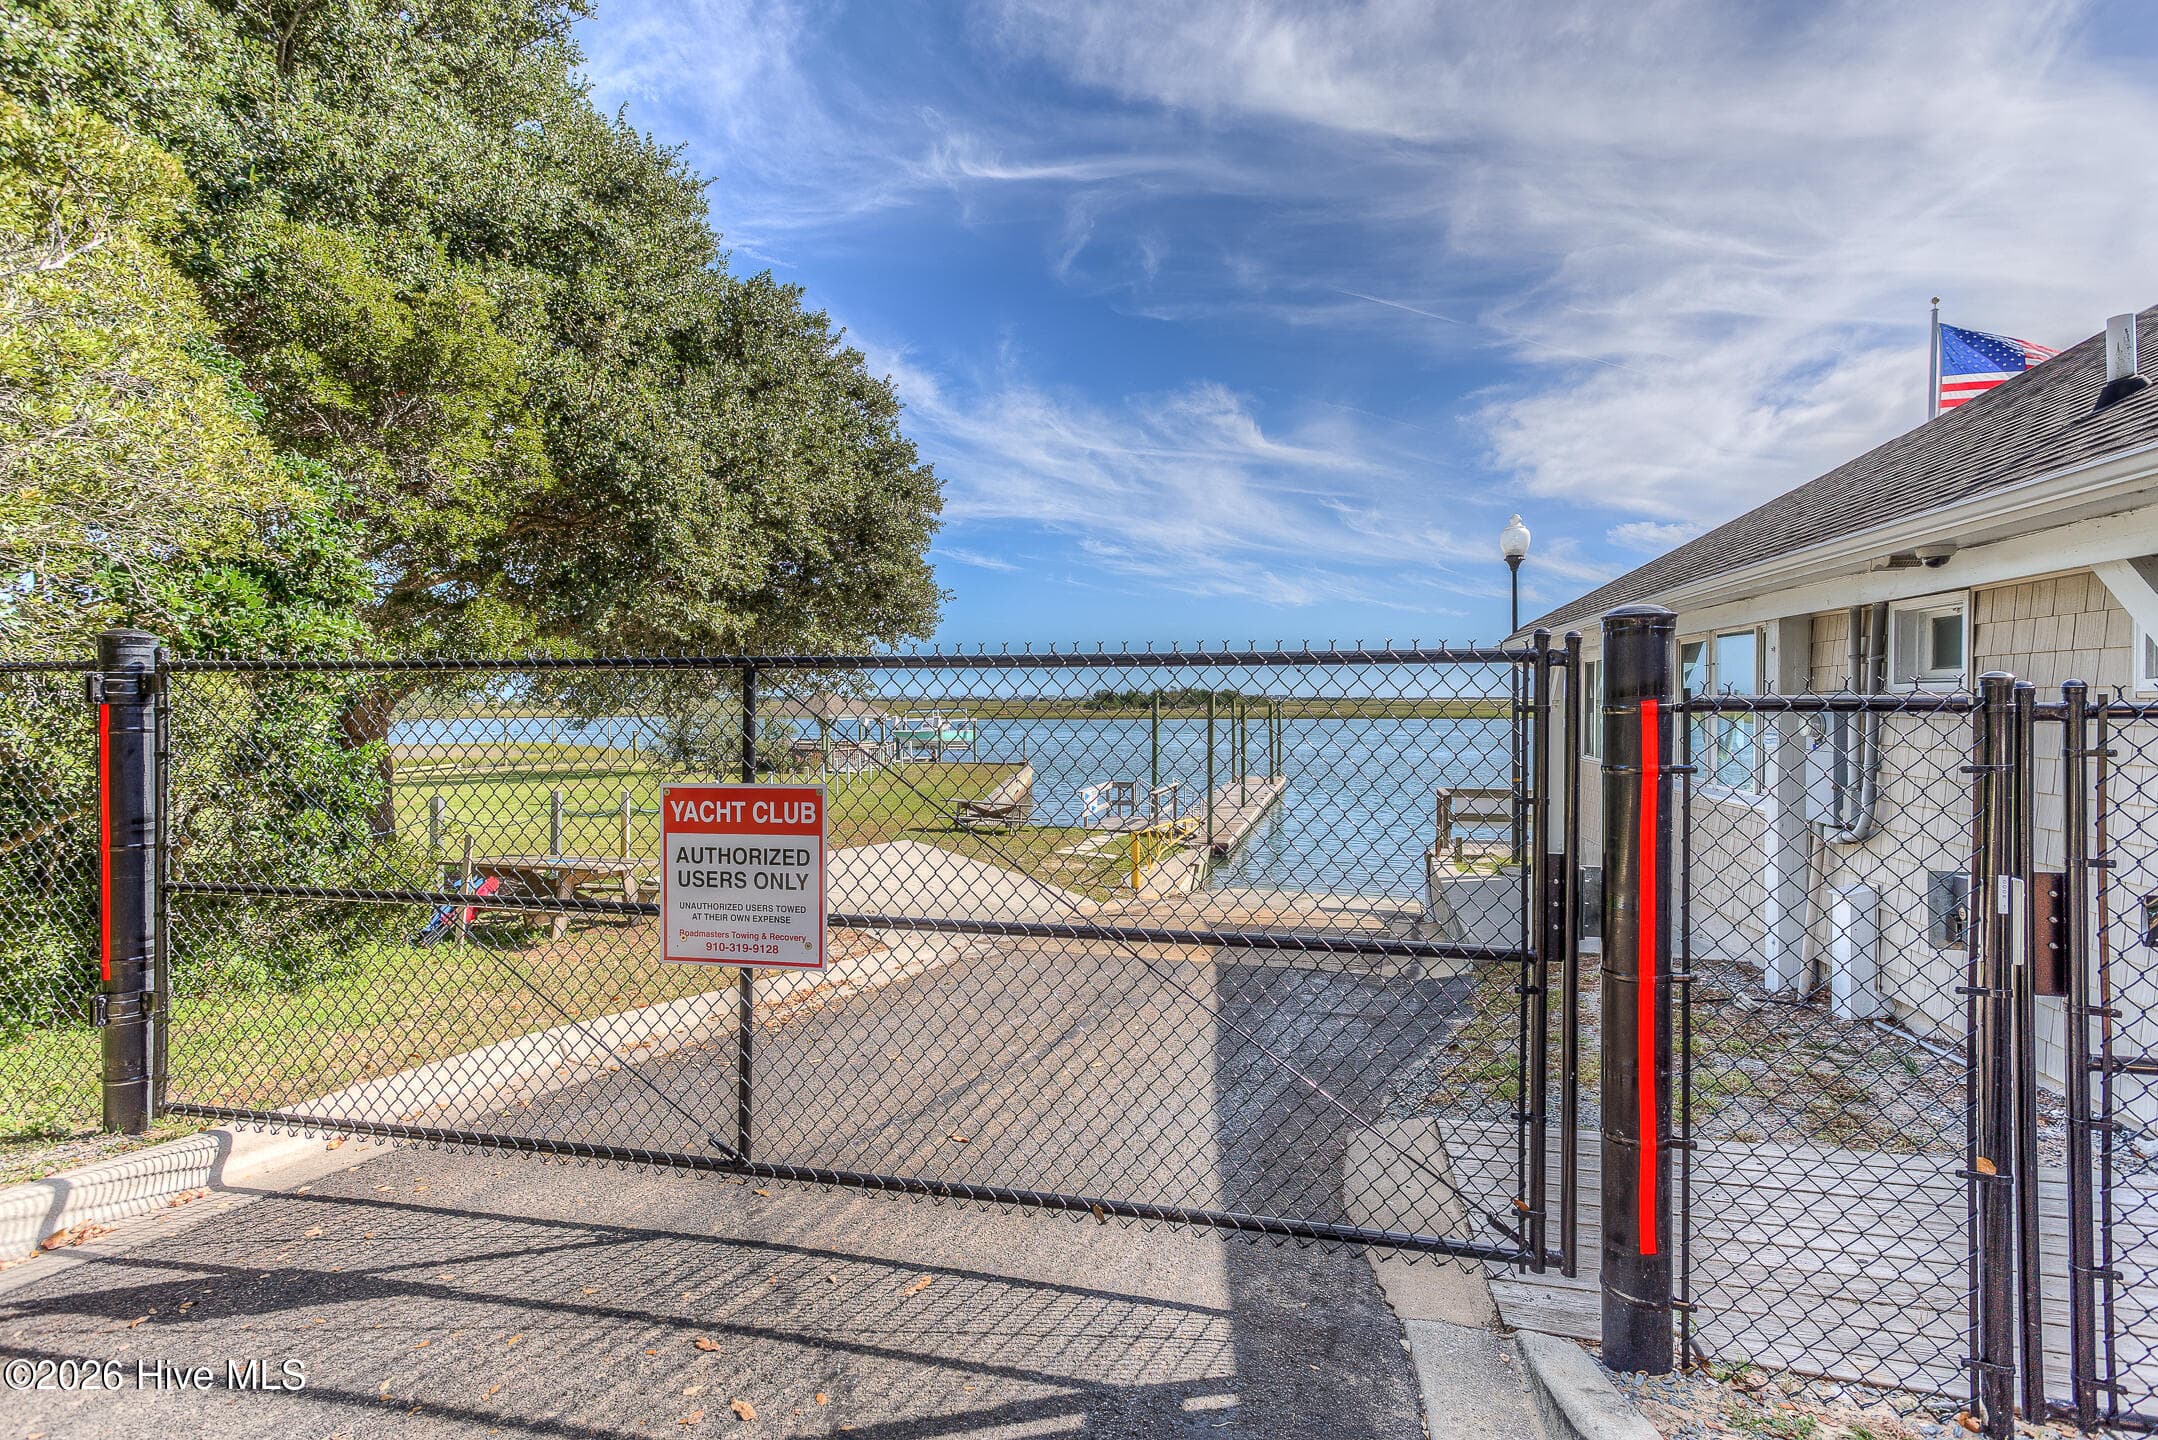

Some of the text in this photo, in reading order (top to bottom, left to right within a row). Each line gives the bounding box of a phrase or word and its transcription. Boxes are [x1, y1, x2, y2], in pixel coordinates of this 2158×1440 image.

[670, 800, 816, 824] YACHT CLUB
[676, 846, 811, 867] AUTHORIZED
[677, 870, 809, 891] USERS ONLY
[679, 901, 807, 914] UNAUTHORIZED USERS TOWED
[692, 913, 791, 924] AT THEIR OWN EXPENSE
[679, 929, 807, 943] Roadmasters Towing & Recovery
[705, 942, 779, 954] 910-319-9128
